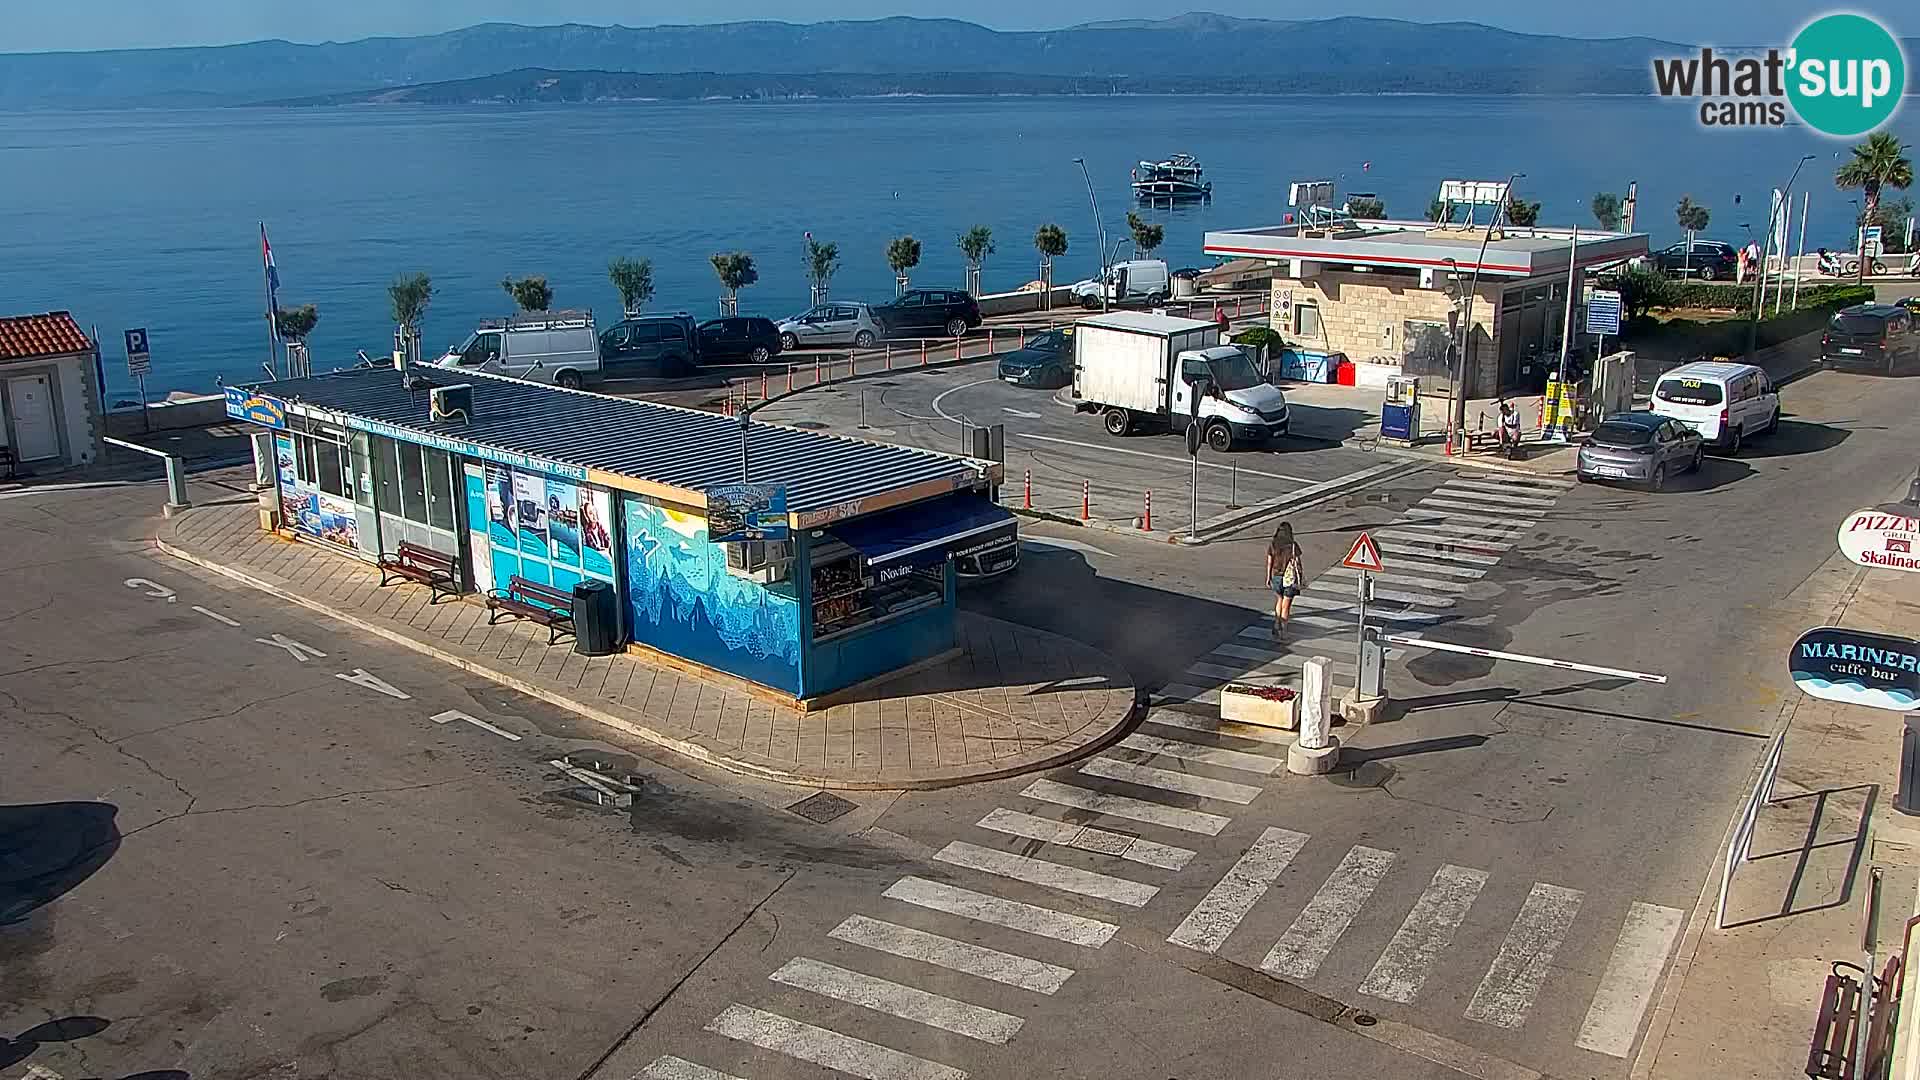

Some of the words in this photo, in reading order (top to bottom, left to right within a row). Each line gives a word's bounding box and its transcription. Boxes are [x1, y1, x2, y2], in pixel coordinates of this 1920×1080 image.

[1681, 379, 1701, 389] TAXI
[436, 437, 467, 452] POSTAJA
[478, 446, 492, 459] BUS
[493, 450, 526, 464] STATION
[529, 457, 554, 471] TICKET
[556, 463, 582, 477] OFFICE
[1849, 516, 1920, 533] PIZZE
[1882, 530, 1918, 541] GRILL
[1801, 642, 1920, 674] MARINER
[1830, 663, 1867, 676] caffe
[1871, 666, 1898, 681] bar
